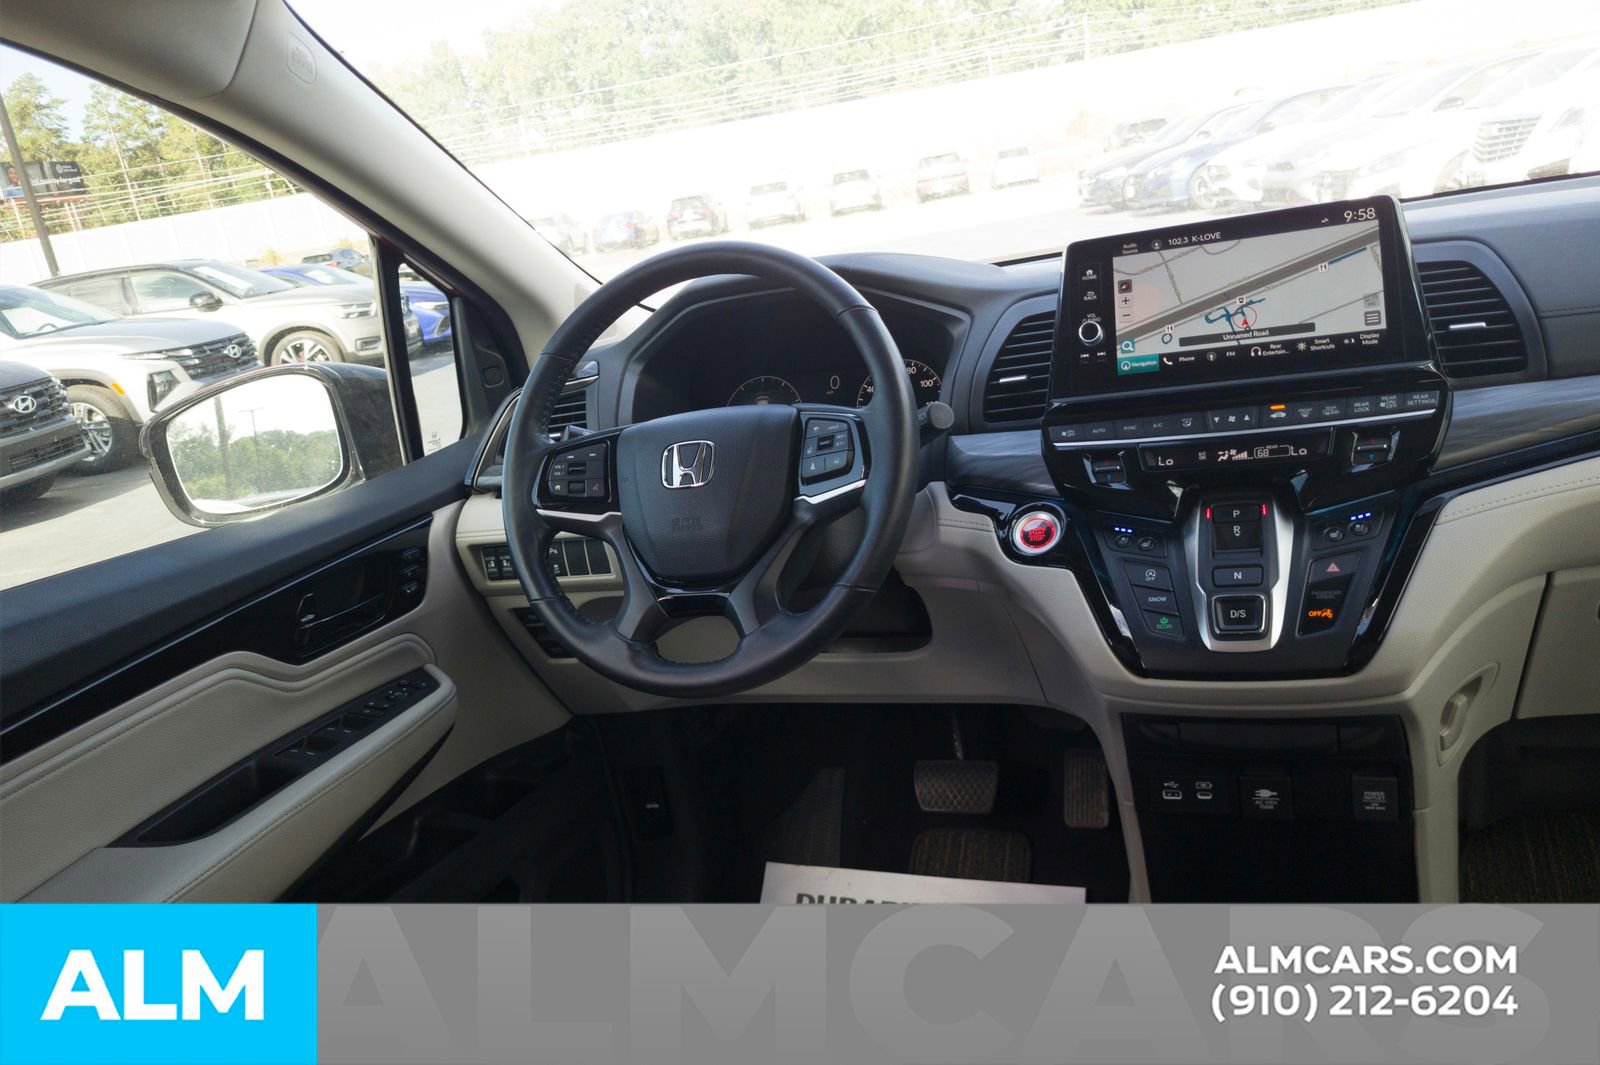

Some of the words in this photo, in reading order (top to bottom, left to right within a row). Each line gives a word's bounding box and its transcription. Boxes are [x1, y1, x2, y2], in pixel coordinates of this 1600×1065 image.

[1344, 208, 1376, 222] 9:58
[1168, 236, 1189, 246] 102.3
[1191, 232, 1222, 243] K-LOVE
[1223, 331, 1252, 341] Unnamed
[1253, 329, 1269, 337] Road
[1360, 332, 1379, 340] Display
[830, 375, 840, 389] 0
[920, 379, 933, 387] 100
[1257, 448, 1269, 457] 68
[1158, 456, 1174, 466] Lo
[1233, 510, 1240, 518] P
[1233, 526, 1240, 534] R
[1233, 572, 1242, 580] N
[1230, 609, 1247, 618] D/S
